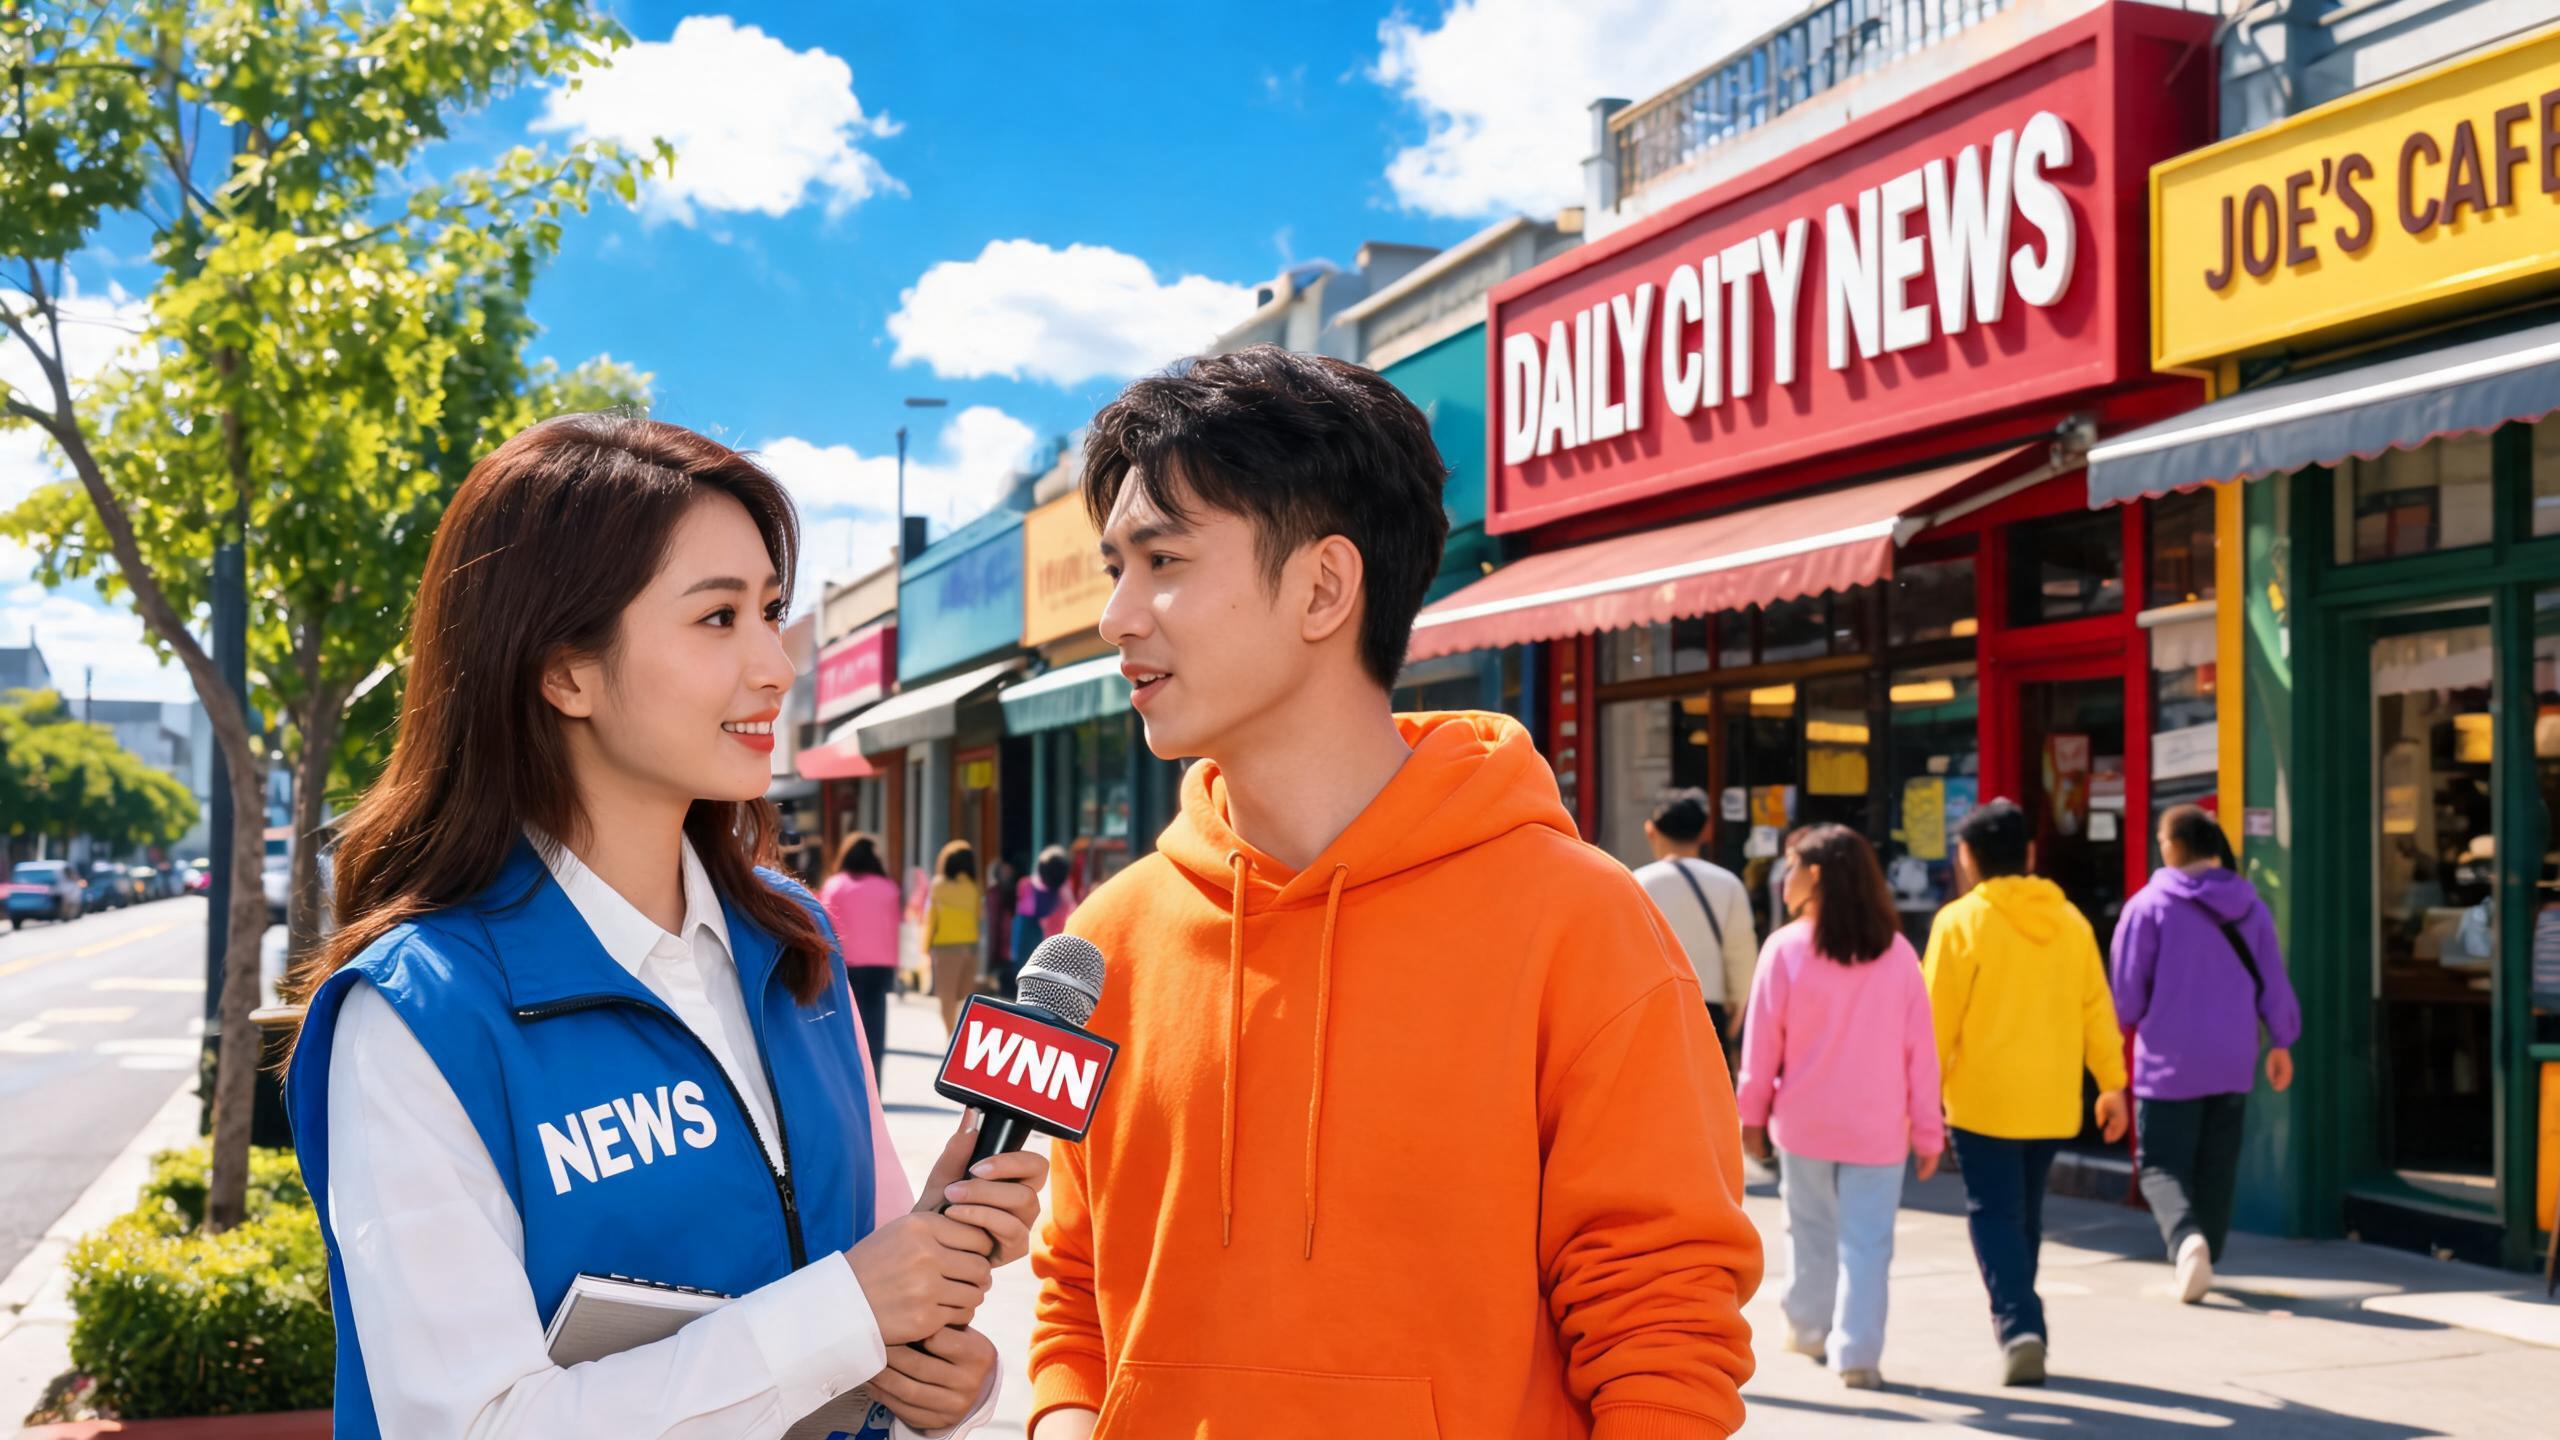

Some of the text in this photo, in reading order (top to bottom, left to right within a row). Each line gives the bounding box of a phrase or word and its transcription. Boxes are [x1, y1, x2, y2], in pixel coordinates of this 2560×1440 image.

[2204, 152, 2375, 292] JOE'S
[1503, 110, 2076, 465] DAILY CITY NEWS
[963, 1020, 1099, 1110] WNN
[537, 1080, 718, 1195] NEWS
